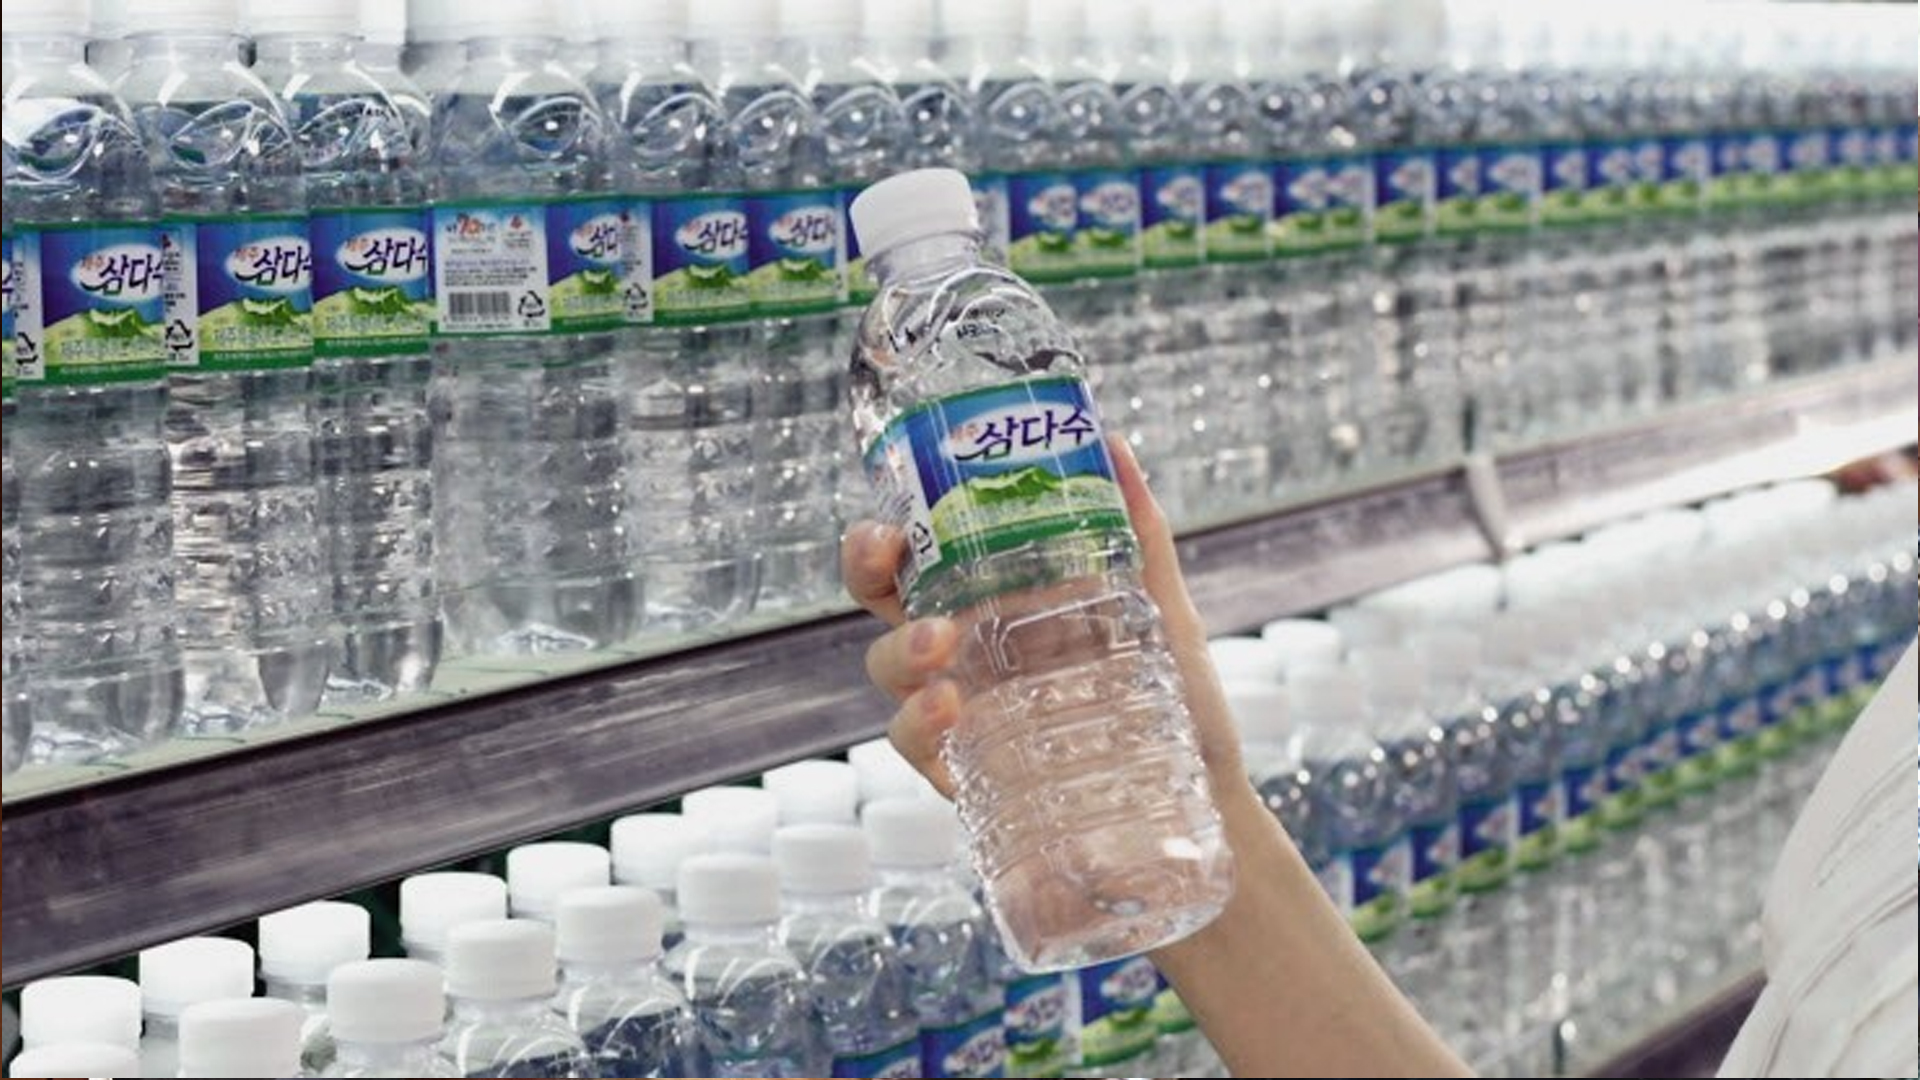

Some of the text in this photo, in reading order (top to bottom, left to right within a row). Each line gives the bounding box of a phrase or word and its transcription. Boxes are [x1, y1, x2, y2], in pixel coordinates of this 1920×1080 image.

[576, 222, 618, 257] 삼다
[684, 219, 748, 251] 삼다
[777, 215, 836, 247] 삼다
[954, 406, 1095, 461] 삼다수
